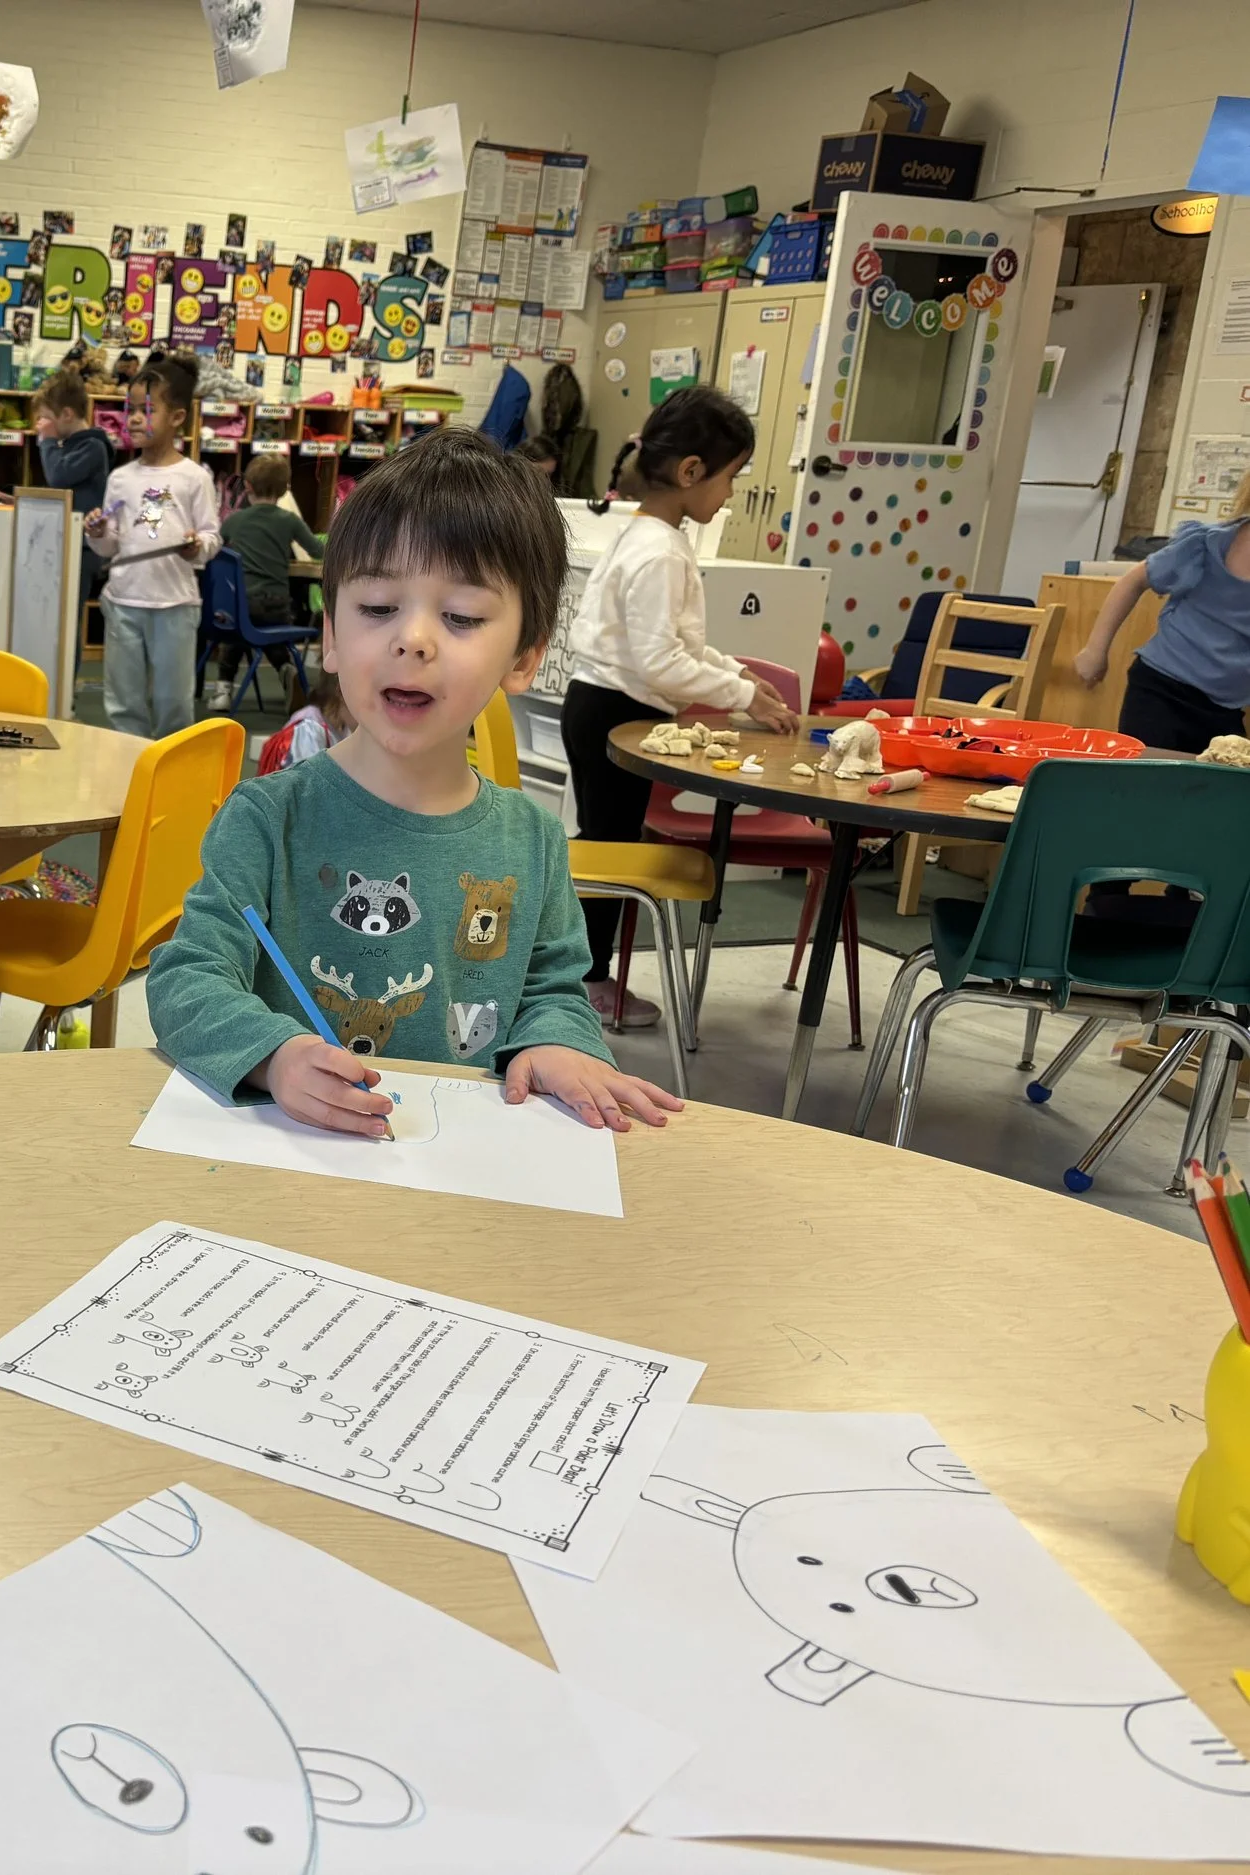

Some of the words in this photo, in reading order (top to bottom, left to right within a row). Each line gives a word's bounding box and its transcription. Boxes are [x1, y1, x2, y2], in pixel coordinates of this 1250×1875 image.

[823, 160, 865, 178] chewy
[901, 159, 956, 185] chewy
[358, 946, 390, 958] JACK
[601, 1402, 624, 1418] Let's
[591, 1418, 615, 1437] Draw
[574, 1445, 599, 1465] Polar
[561, 1464, 587, 1487] Bear!
